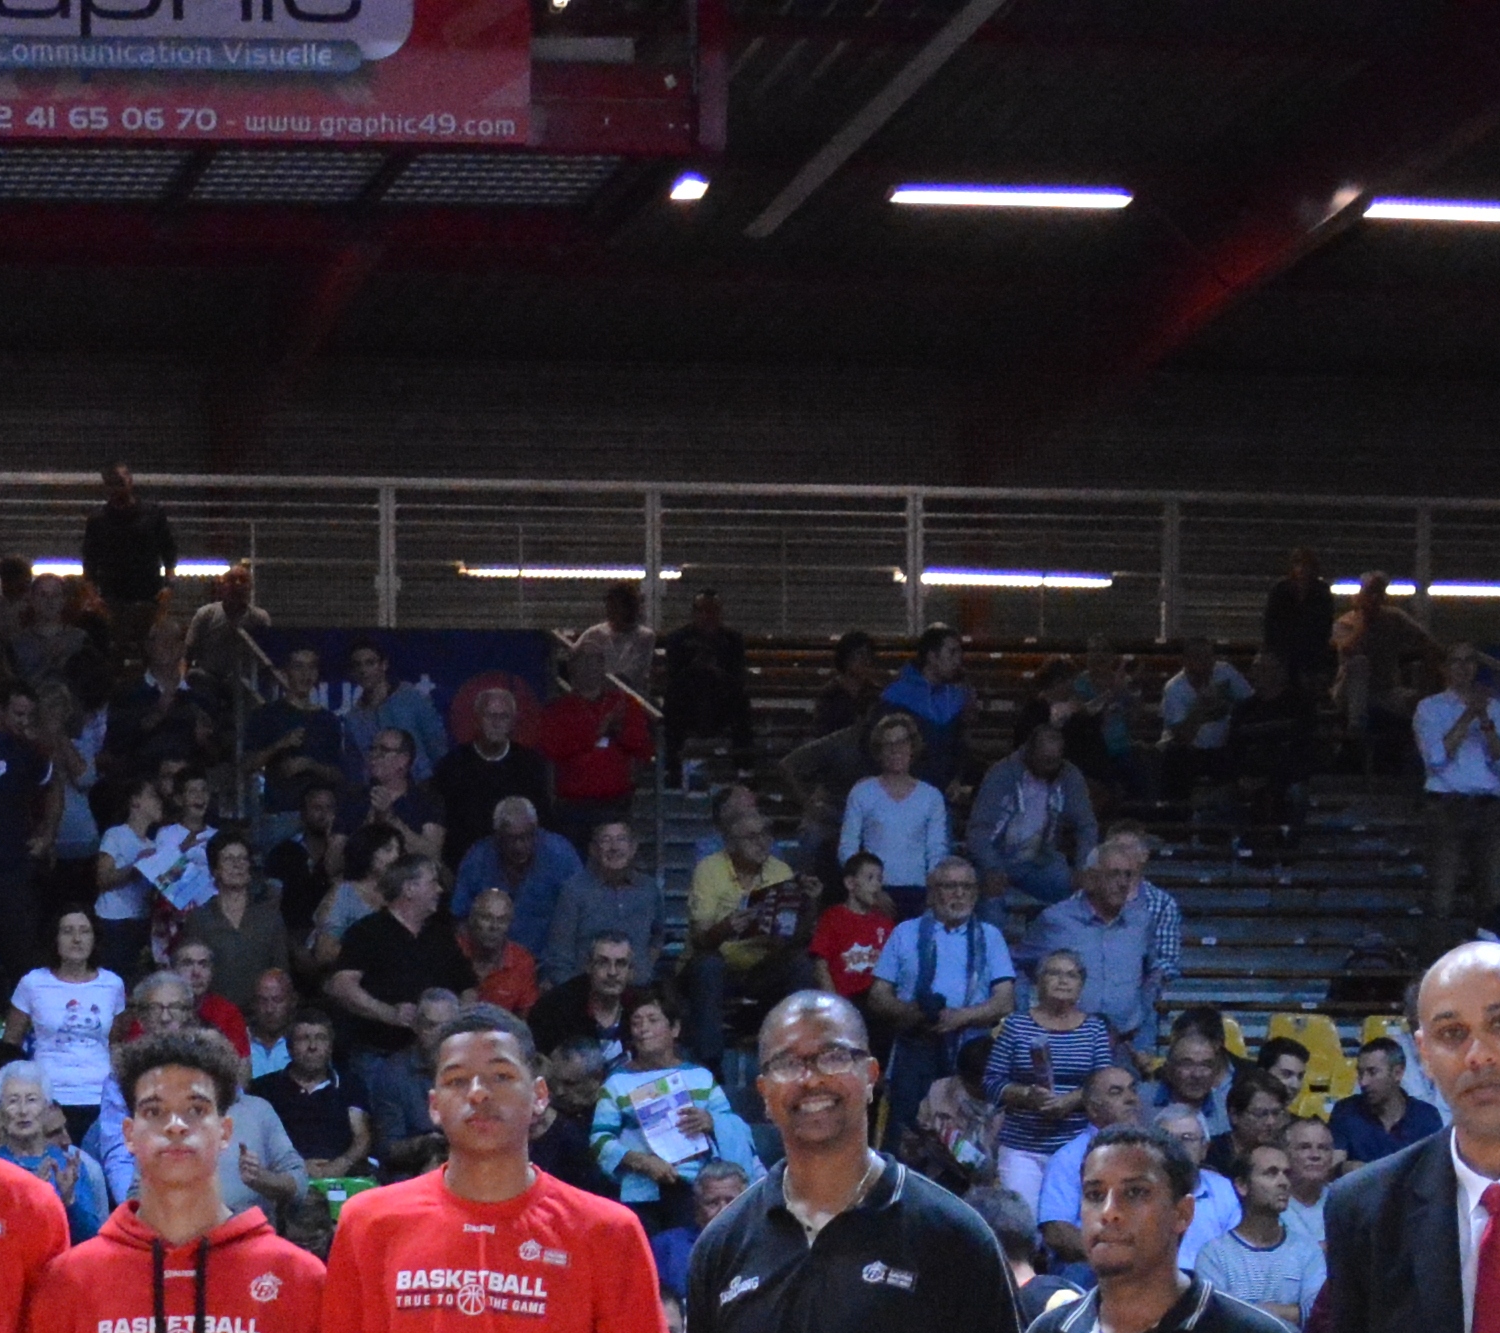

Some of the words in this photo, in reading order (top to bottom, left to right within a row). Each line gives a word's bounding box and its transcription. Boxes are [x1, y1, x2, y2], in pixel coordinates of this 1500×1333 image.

[222, 43, 332, 66] Visuelle
[25, 107, 56, 130] 41
[68, 108, 109, 131] 65
[121, 108, 164, 132] 06
[176, 108, 217, 132] 70
[245, 112, 516, 138] www.graphic49.com
[395, 1269, 548, 1298] BASKETBALL
[395, 1294, 431, 1307] TRUE
[437, 1293, 454, 1305] TO
[489, 1296, 508, 1311] THE
[512, 1300, 547, 1315] GAME
